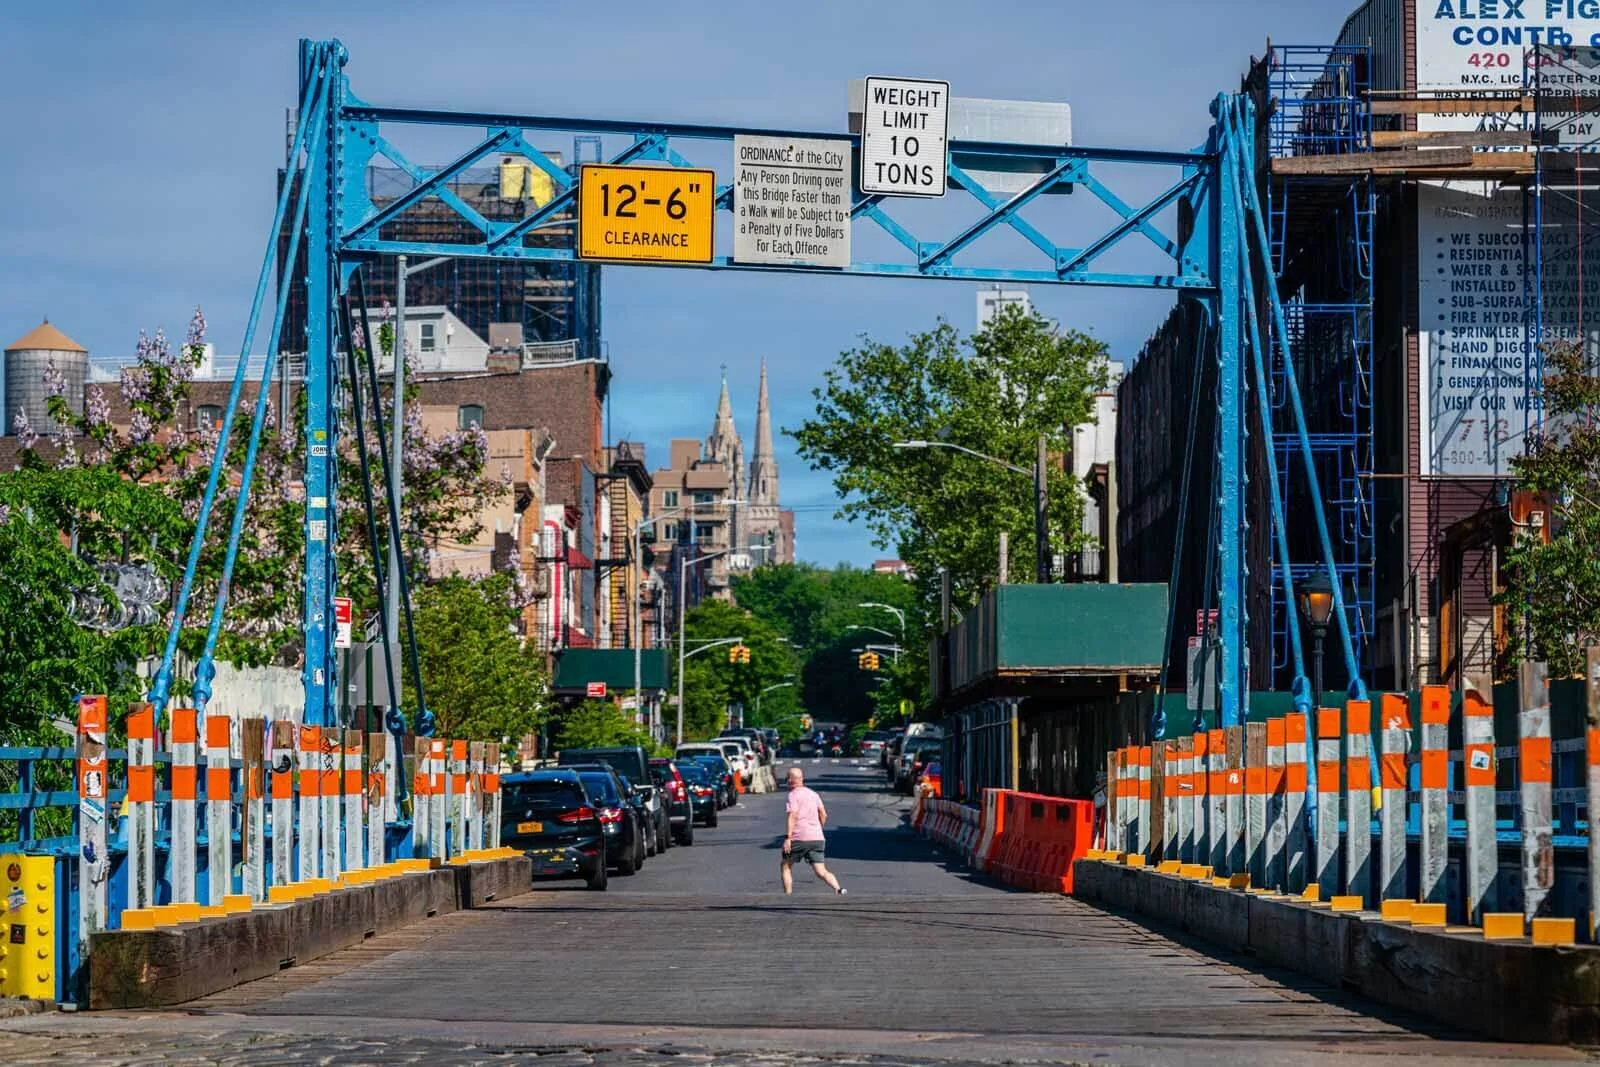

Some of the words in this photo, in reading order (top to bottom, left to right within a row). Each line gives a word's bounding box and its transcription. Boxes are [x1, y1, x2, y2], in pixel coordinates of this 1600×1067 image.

[1435, 0, 1525, 19] ALEX
[1545, 0, 1600, 19] FIG
[1468, 53, 1510, 68] 420
[1461, 74, 1494, 84] N.Y.C.
[874, 87, 940, 108] WEIGHT
[883, 110, 928, 130] LIMIT
[1568, 124, 1592, 135] DAY
[890, 136, 920, 157] 10
[740, 146, 792, 162] ORDINANCE
[796, 150, 804, 162] of
[808, 151, 822, 164] the
[824, 152, 844, 168] City
[740, 169, 758, 186] Any
[760, 170, 790, 184] Person
[792, 172, 822, 190] Driving
[825, 176, 844, 188] over
[874, 162, 933, 186] TONS
[601, 180, 700, 220] 12'-6"
[744, 187, 760, 200] this
[762, 188, 789, 205] Bridge
[792, 190, 818, 204] Faster
[822, 192, 840, 204] than
[740, 206, 746, 216] a
[748, 204, 768, 218] Walk
[770, 206, 784, 219] will
[787, 208, 798, 220] be
[800, 206, 832, 224] Subject
[835, 210, 844, 222] to
[604, 230, 688, 247] CLEARANCE
[740, 224, 746, 234] a
[748, 222, 781, 238] Penalty
[784, 224, 792, 236] of
[795, 224, 813, 238] Five
[815, 225, 844, 240] Dollars
[1451, 233, 1470, 245] WE
[757, 239, 770, 252] For
[772, 240, 792, 254] Each
[795, 240, 828, 256] Offence
[1451, 264, 1492, 276] WATER
[1500, 264, 1508, 276] &
[1451, 280, 1516, 292] INSTALLED
[1451, 312, 1476, 323] FIRE
[1451, 327, 1519, 338] SPRINKLER
[1451, 342, 1488, 353] HAND
[1451, 357, 1522, 368] FINANCING
[1449, 377, 1523, 389] GENERATIONS
[1443, 396, 1474, 410] VISIT
[1480, 396, 1505, 410] OUR
